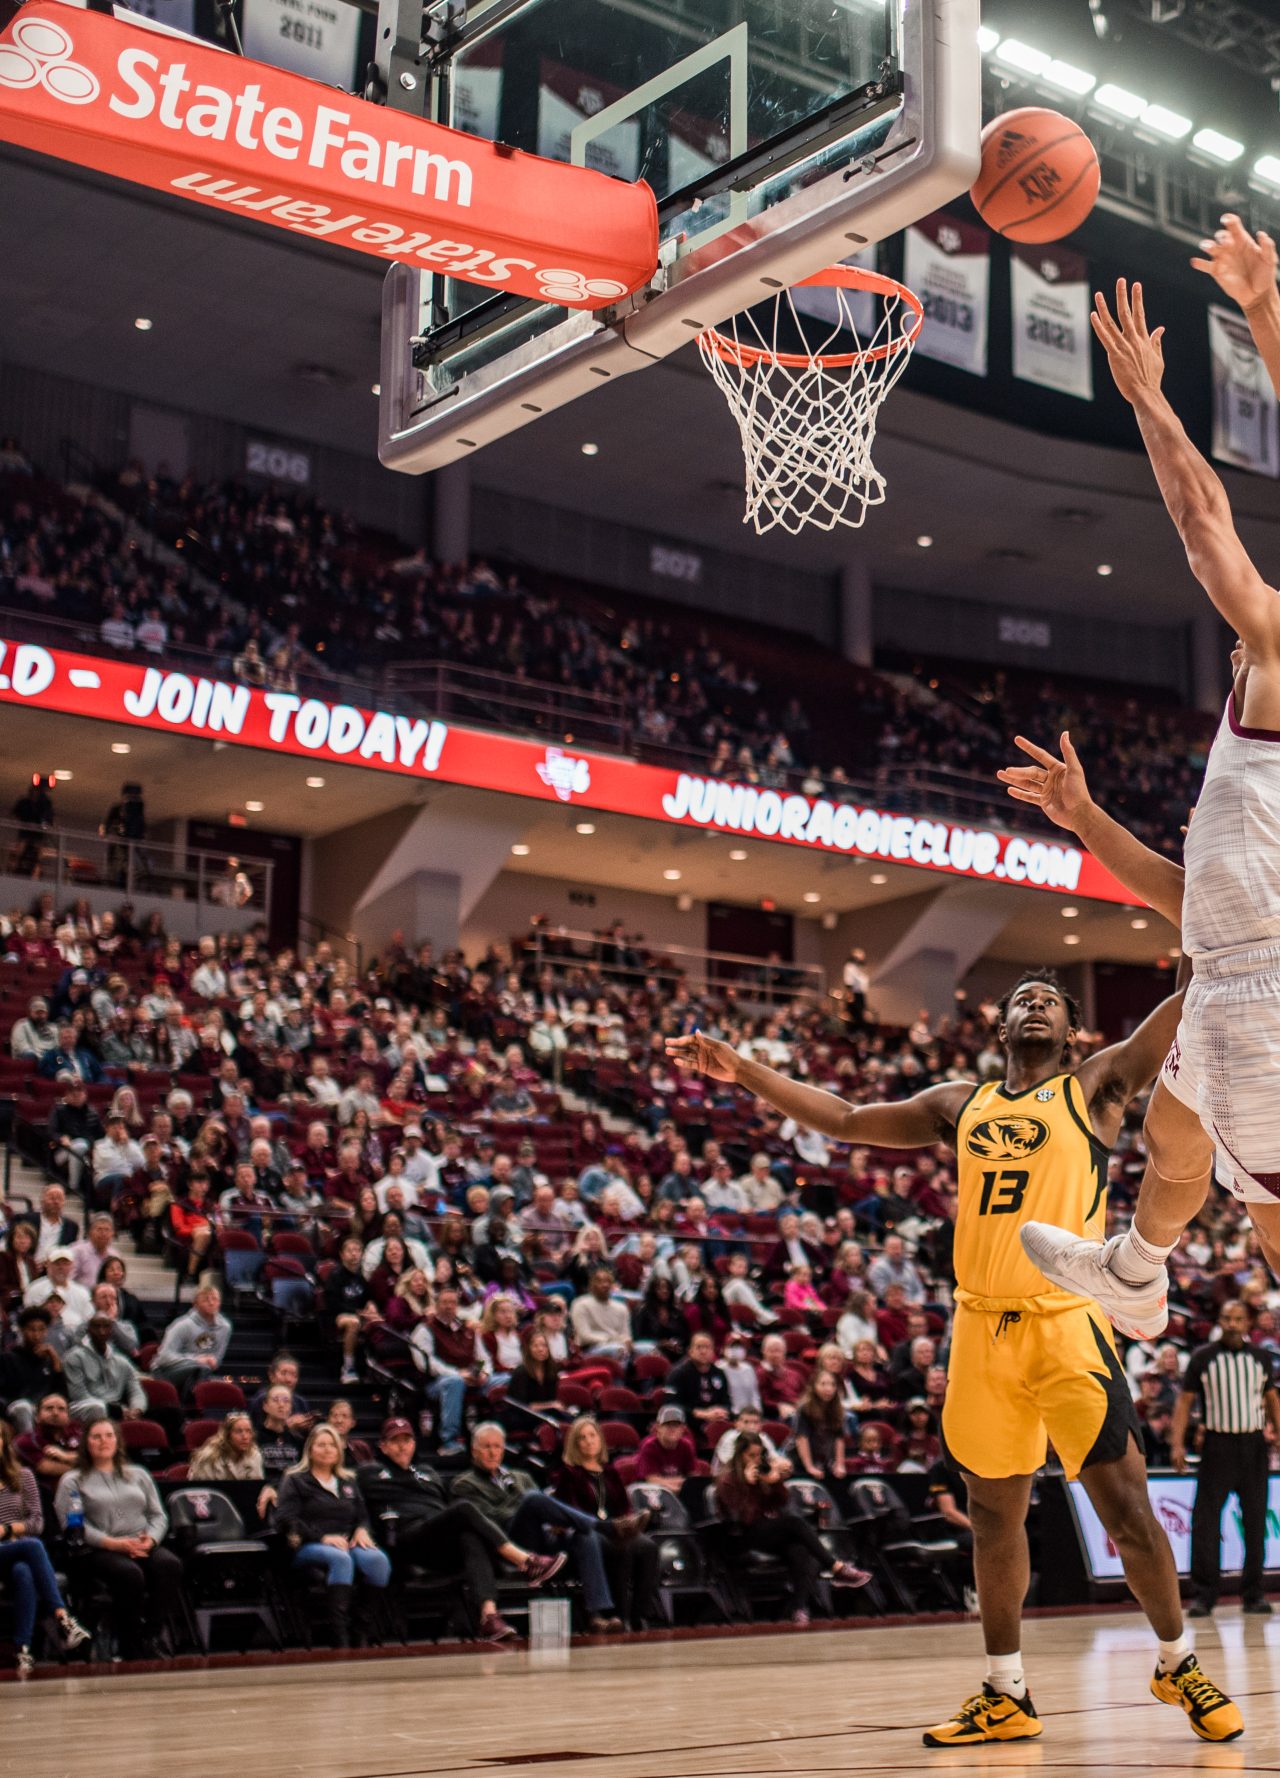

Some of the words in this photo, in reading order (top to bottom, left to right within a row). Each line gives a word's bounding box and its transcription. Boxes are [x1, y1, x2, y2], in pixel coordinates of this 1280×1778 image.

[280, 15, 324, 50] 2011
[921, 289, 974, 334] 2013
[123, 667, 249, 734] JOIN
[264, 692, 447, 772] TODAY!
[979, 1170, 1029, 1216] 13
